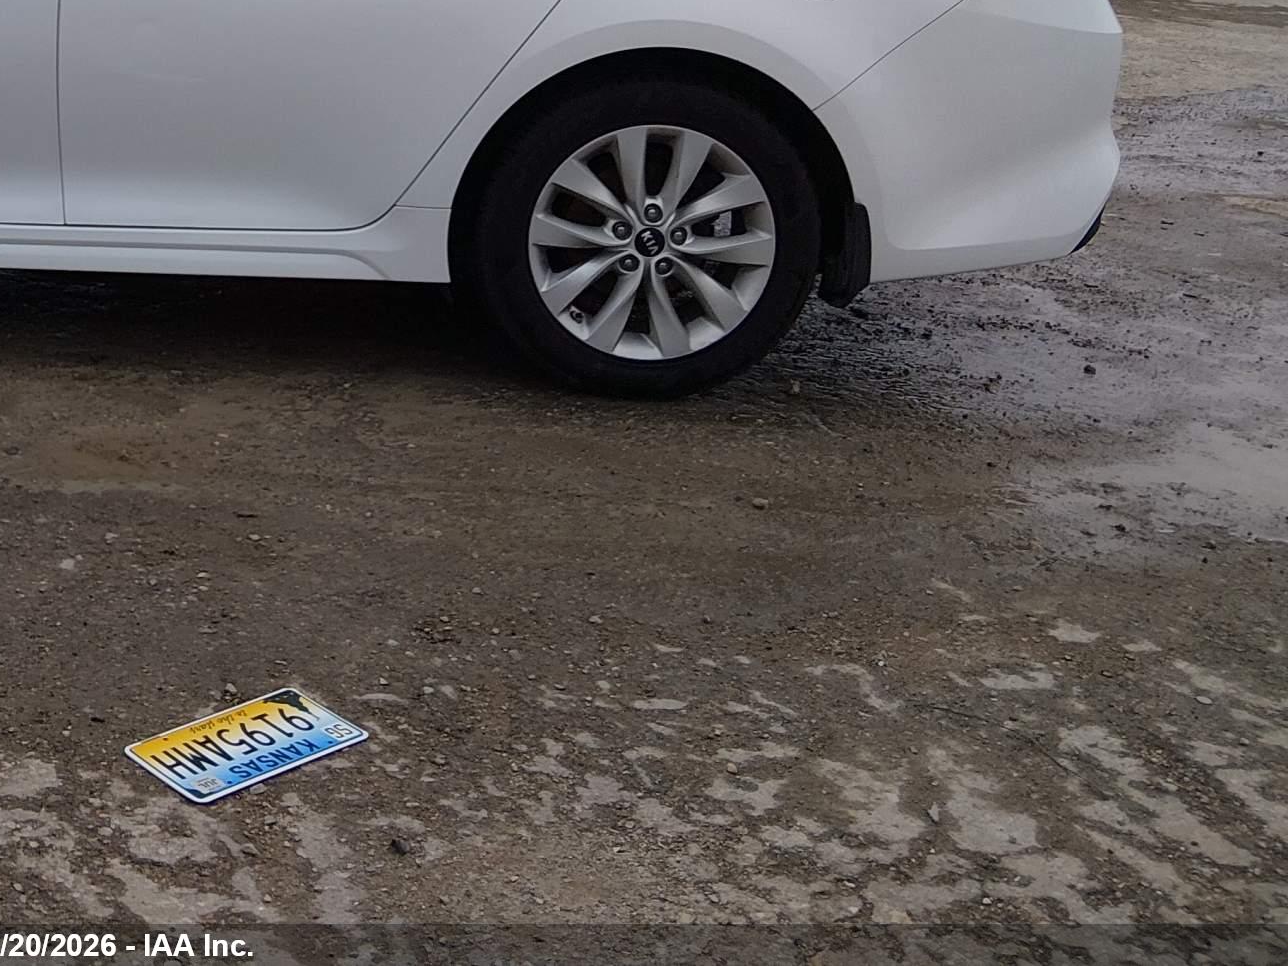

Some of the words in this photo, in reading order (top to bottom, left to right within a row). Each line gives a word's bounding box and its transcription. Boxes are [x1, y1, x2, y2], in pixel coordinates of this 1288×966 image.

[641, 230, 659, 255] KIA
[150, 708, 315, 780] 9195AMH
[228, 738, 321, 779] KANSAS
